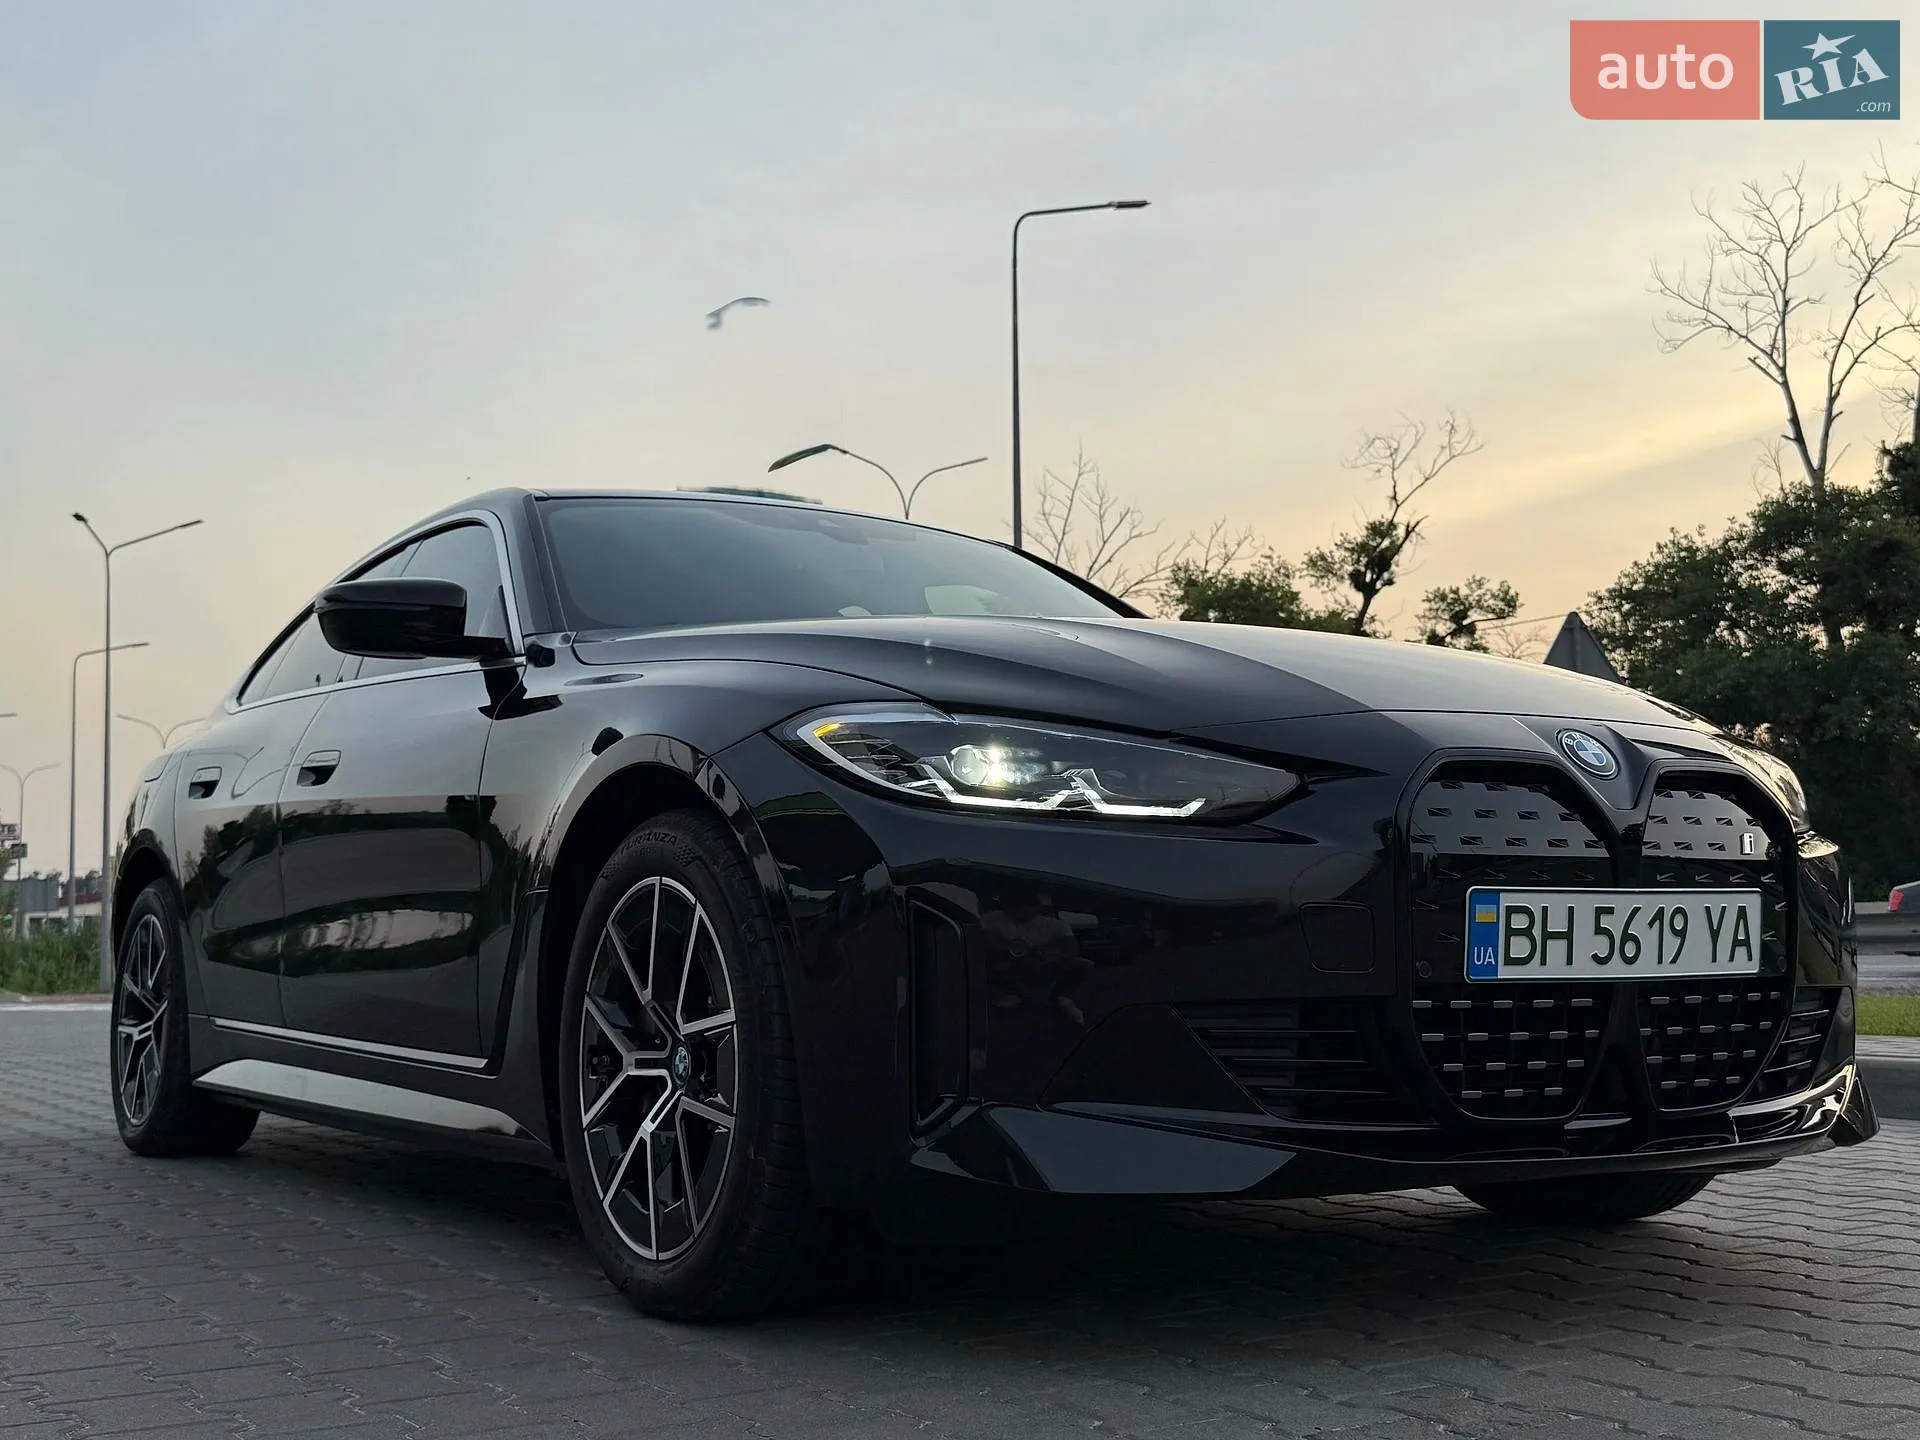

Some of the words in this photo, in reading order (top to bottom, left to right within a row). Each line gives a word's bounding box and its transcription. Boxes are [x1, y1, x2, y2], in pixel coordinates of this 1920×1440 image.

[1503, 903, 1575, 966] BH
[1591, 903, 1690, 965] 5619
[1704, 903, 1753, 963] YA
[1473, 946, 1496, 966] UA
